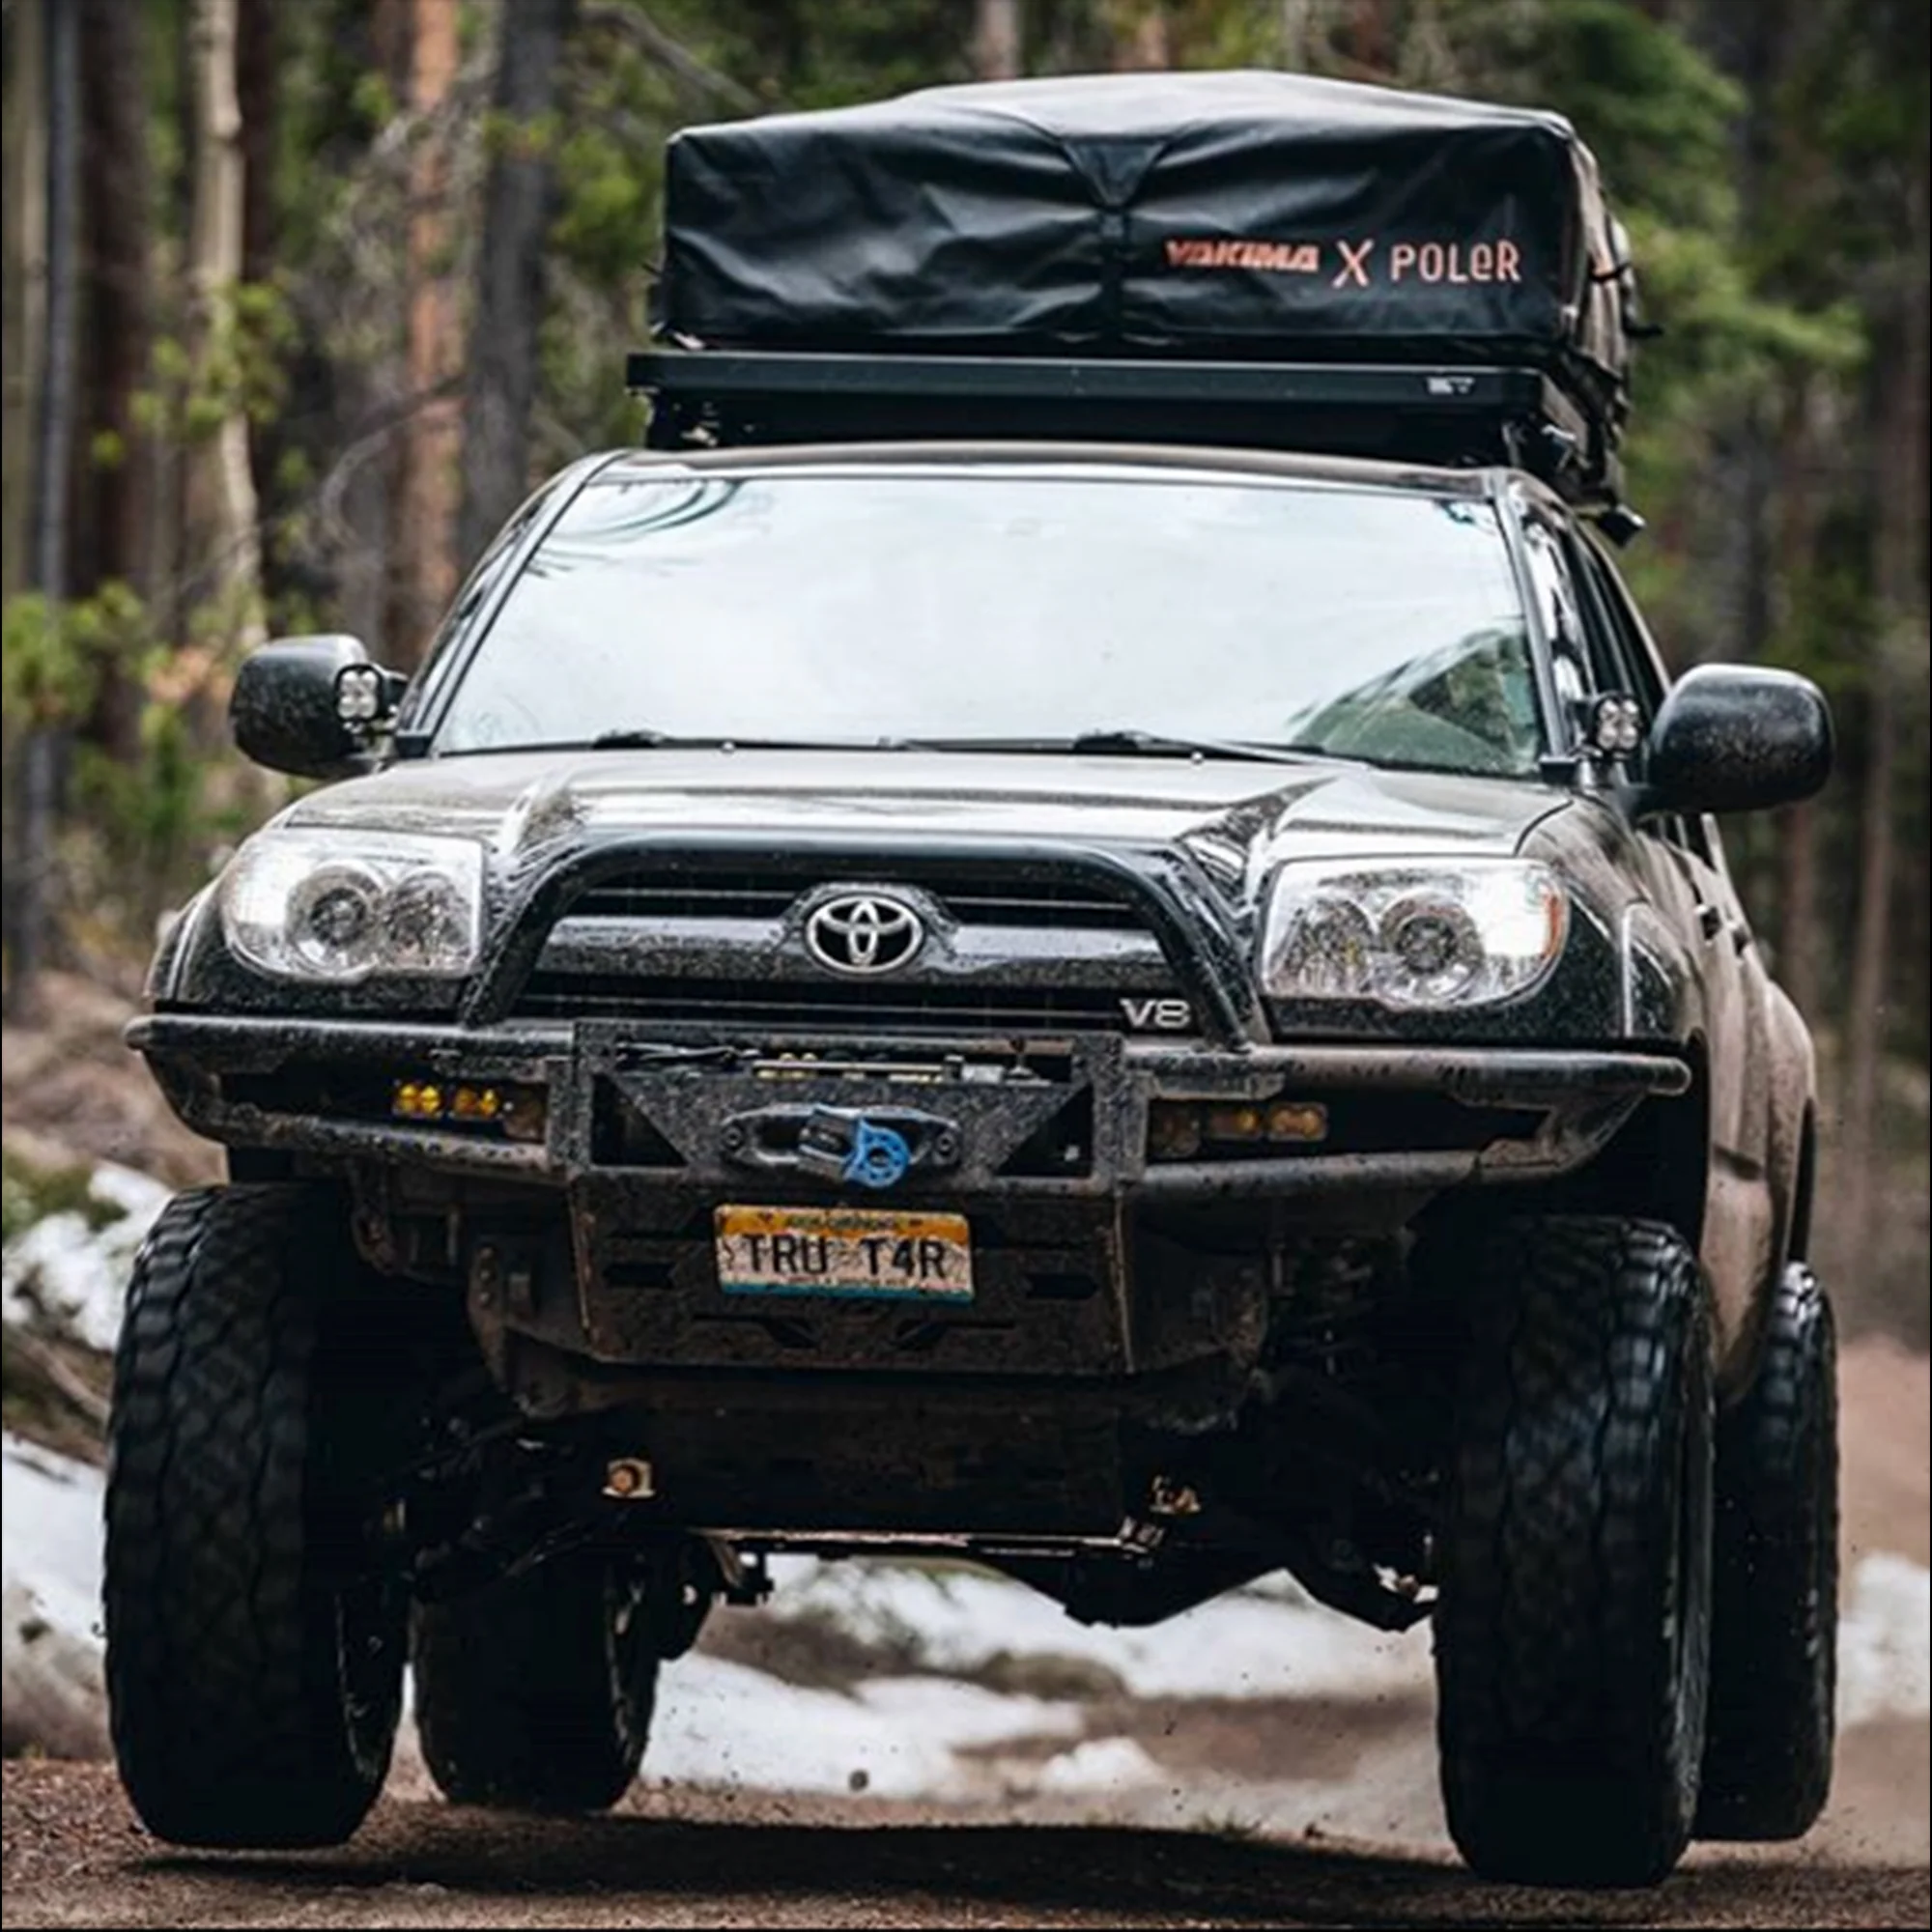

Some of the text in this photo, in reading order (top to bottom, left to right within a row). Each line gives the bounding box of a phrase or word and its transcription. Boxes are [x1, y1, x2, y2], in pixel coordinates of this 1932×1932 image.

[1166, 240, 1320, 272] YAKIMA
[1332, 239, 1375, 288] X
[1120, 998, 1190, 1029] V8
[741, 1234, 948, 1280] TRU T4R
